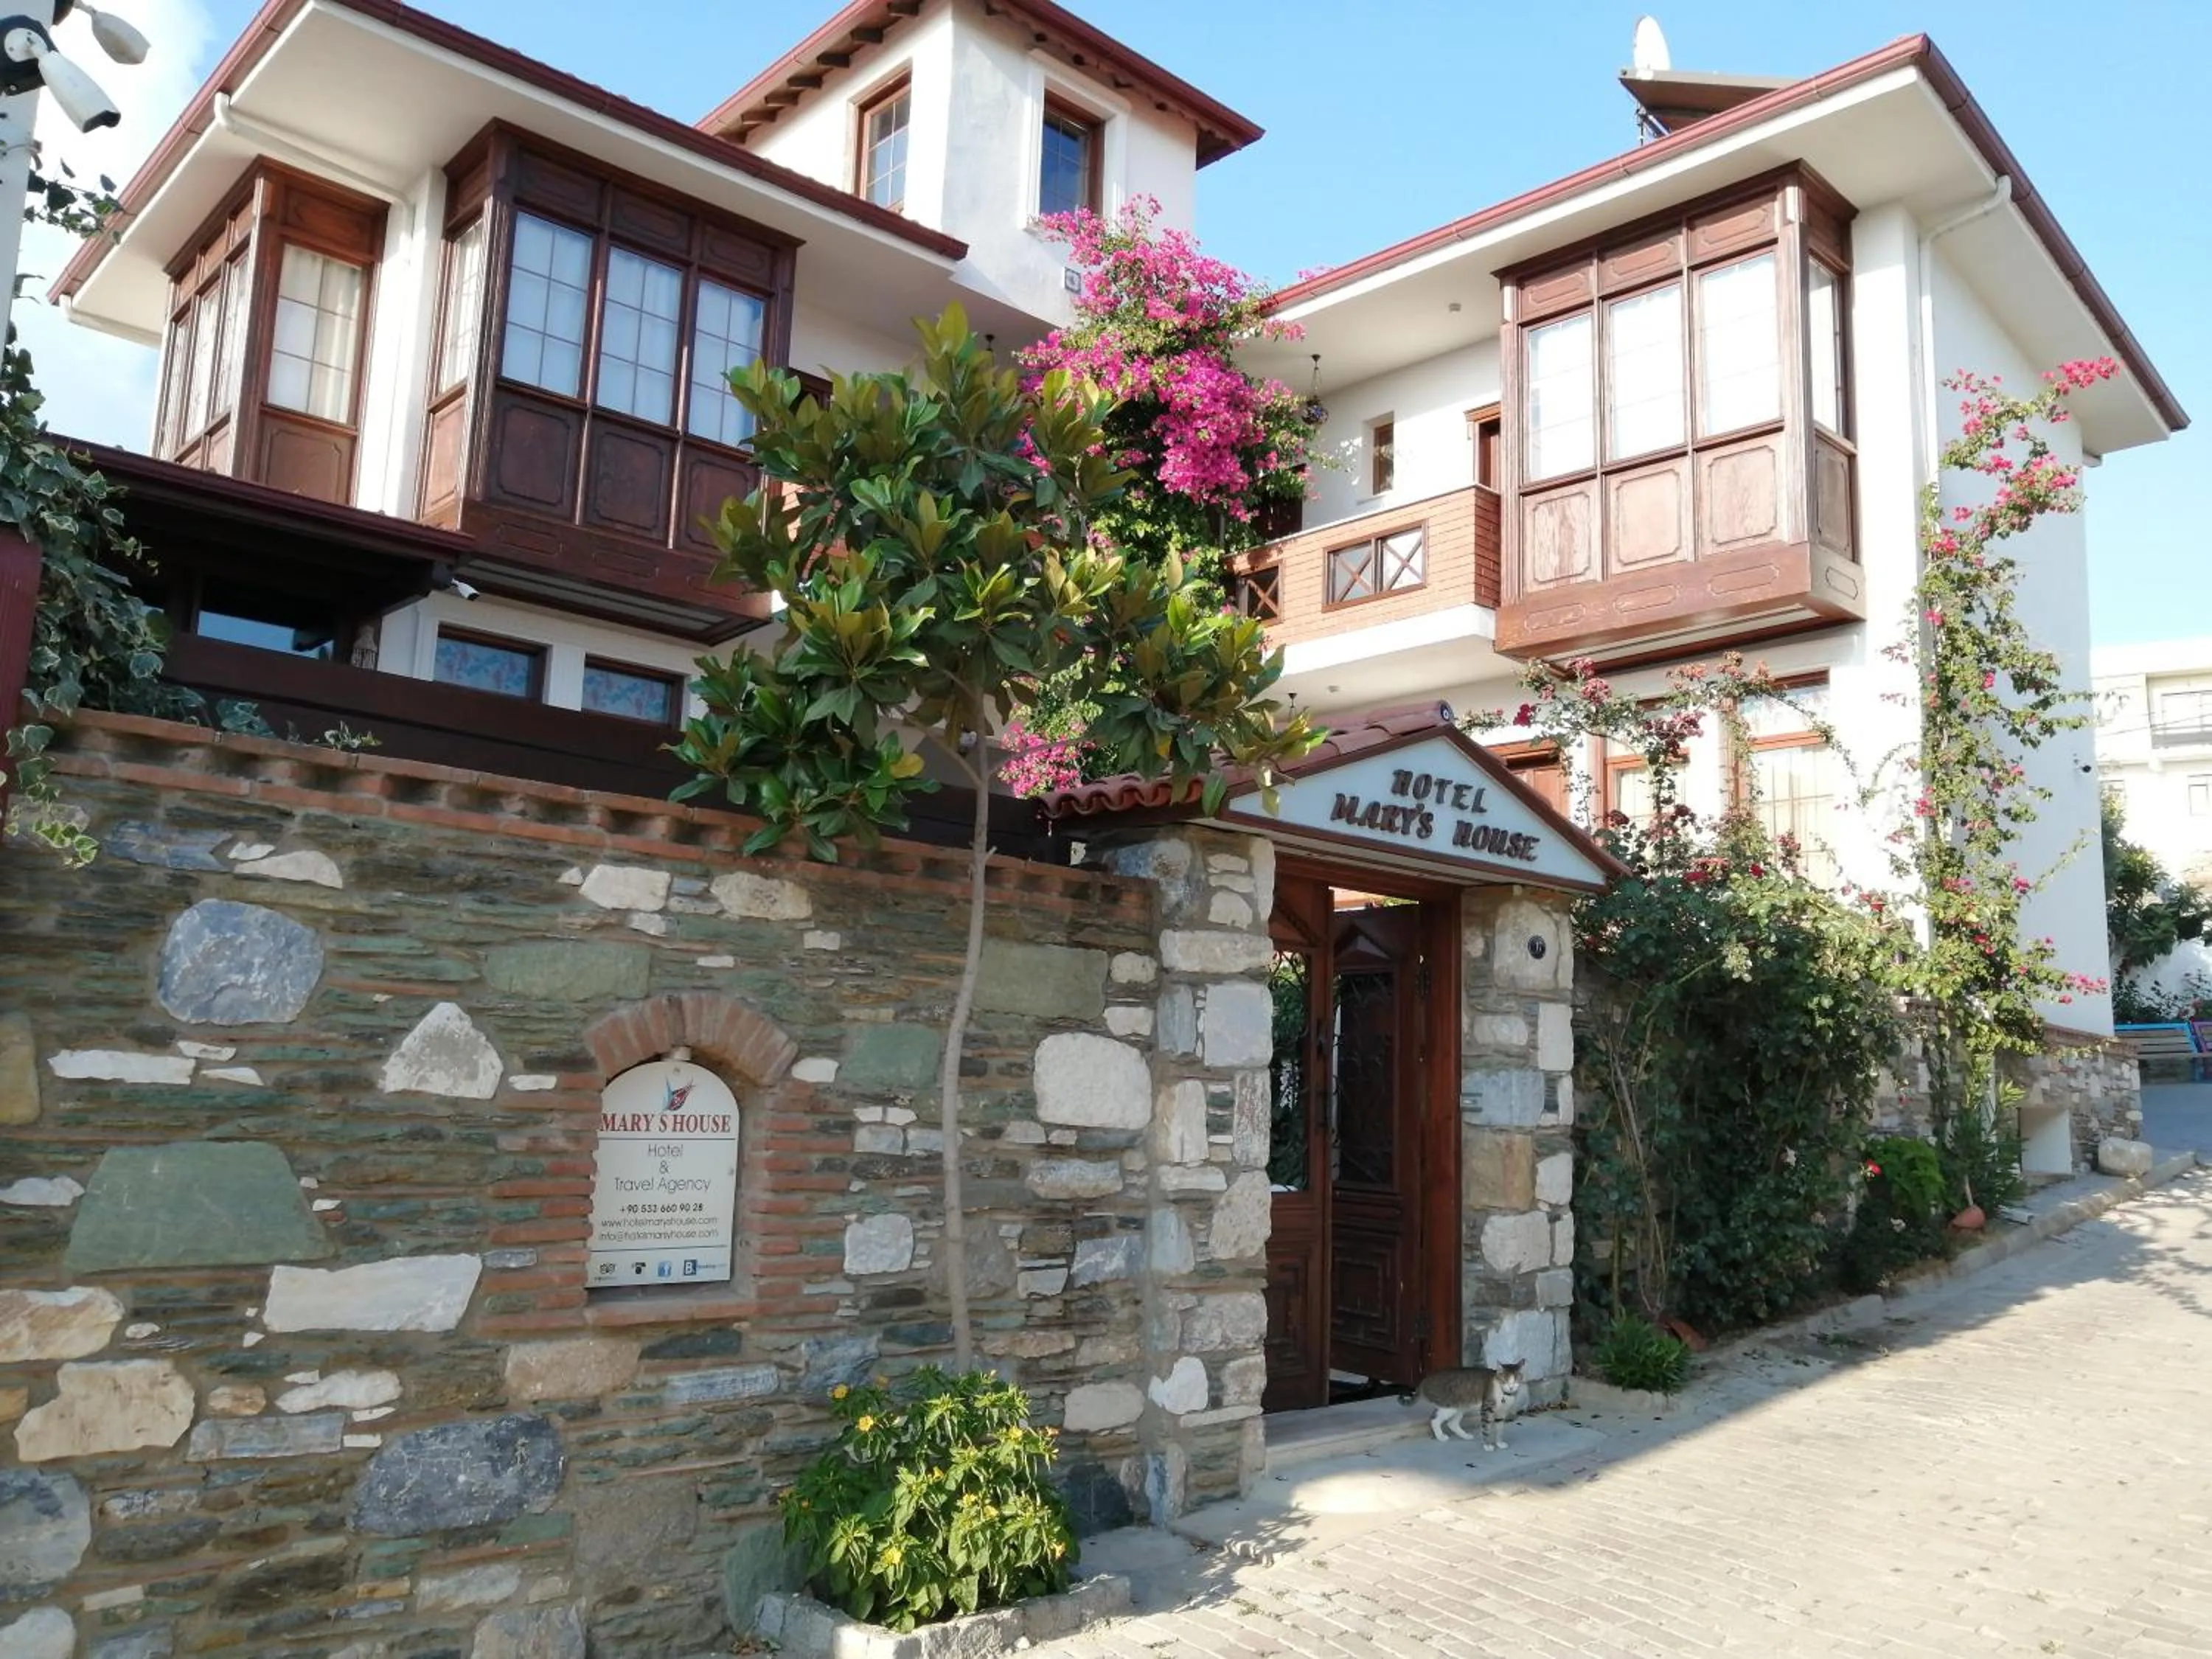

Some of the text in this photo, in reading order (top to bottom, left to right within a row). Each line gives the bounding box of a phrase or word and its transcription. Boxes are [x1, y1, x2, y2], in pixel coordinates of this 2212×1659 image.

[1391, 769, 1487, 813] HOTEL
[1330, 793, 1540, 862] MARY'S HOUSE
[672, 1114, 731, 1133] HOUSE
[647, 1144, 683, 1157] Hotel
[659, 1160, 669, 1174] &
[614, 1177, 712, 1194] Travel Agency
[660, 1203, 677, 1213] 660
[679, 1203, 691, 1211] 90
